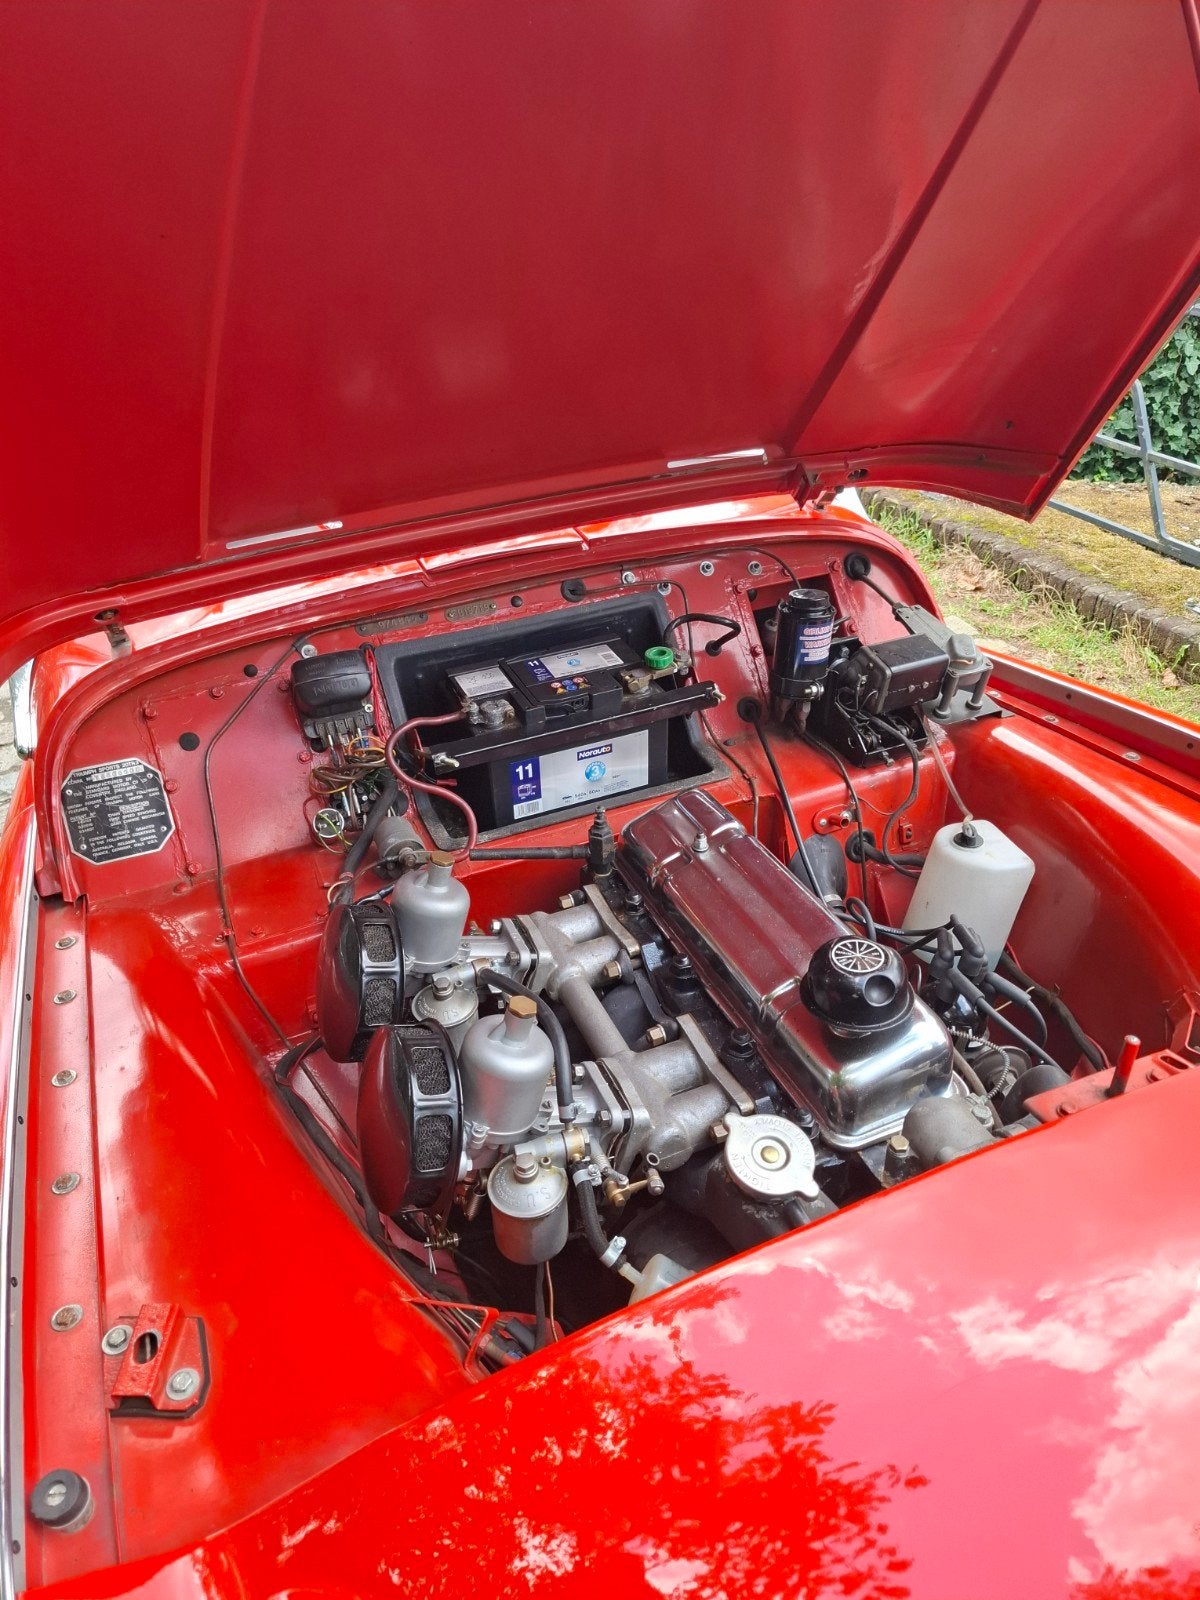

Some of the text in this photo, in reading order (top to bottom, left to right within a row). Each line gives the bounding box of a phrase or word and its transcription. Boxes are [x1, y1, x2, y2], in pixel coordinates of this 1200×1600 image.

[578, 746, 611, 758] Norauto
[73, 769, 97, 778] TRIUMPH
[516, 763, 533, 780] 11
[592, 766, 600, 776] 3
